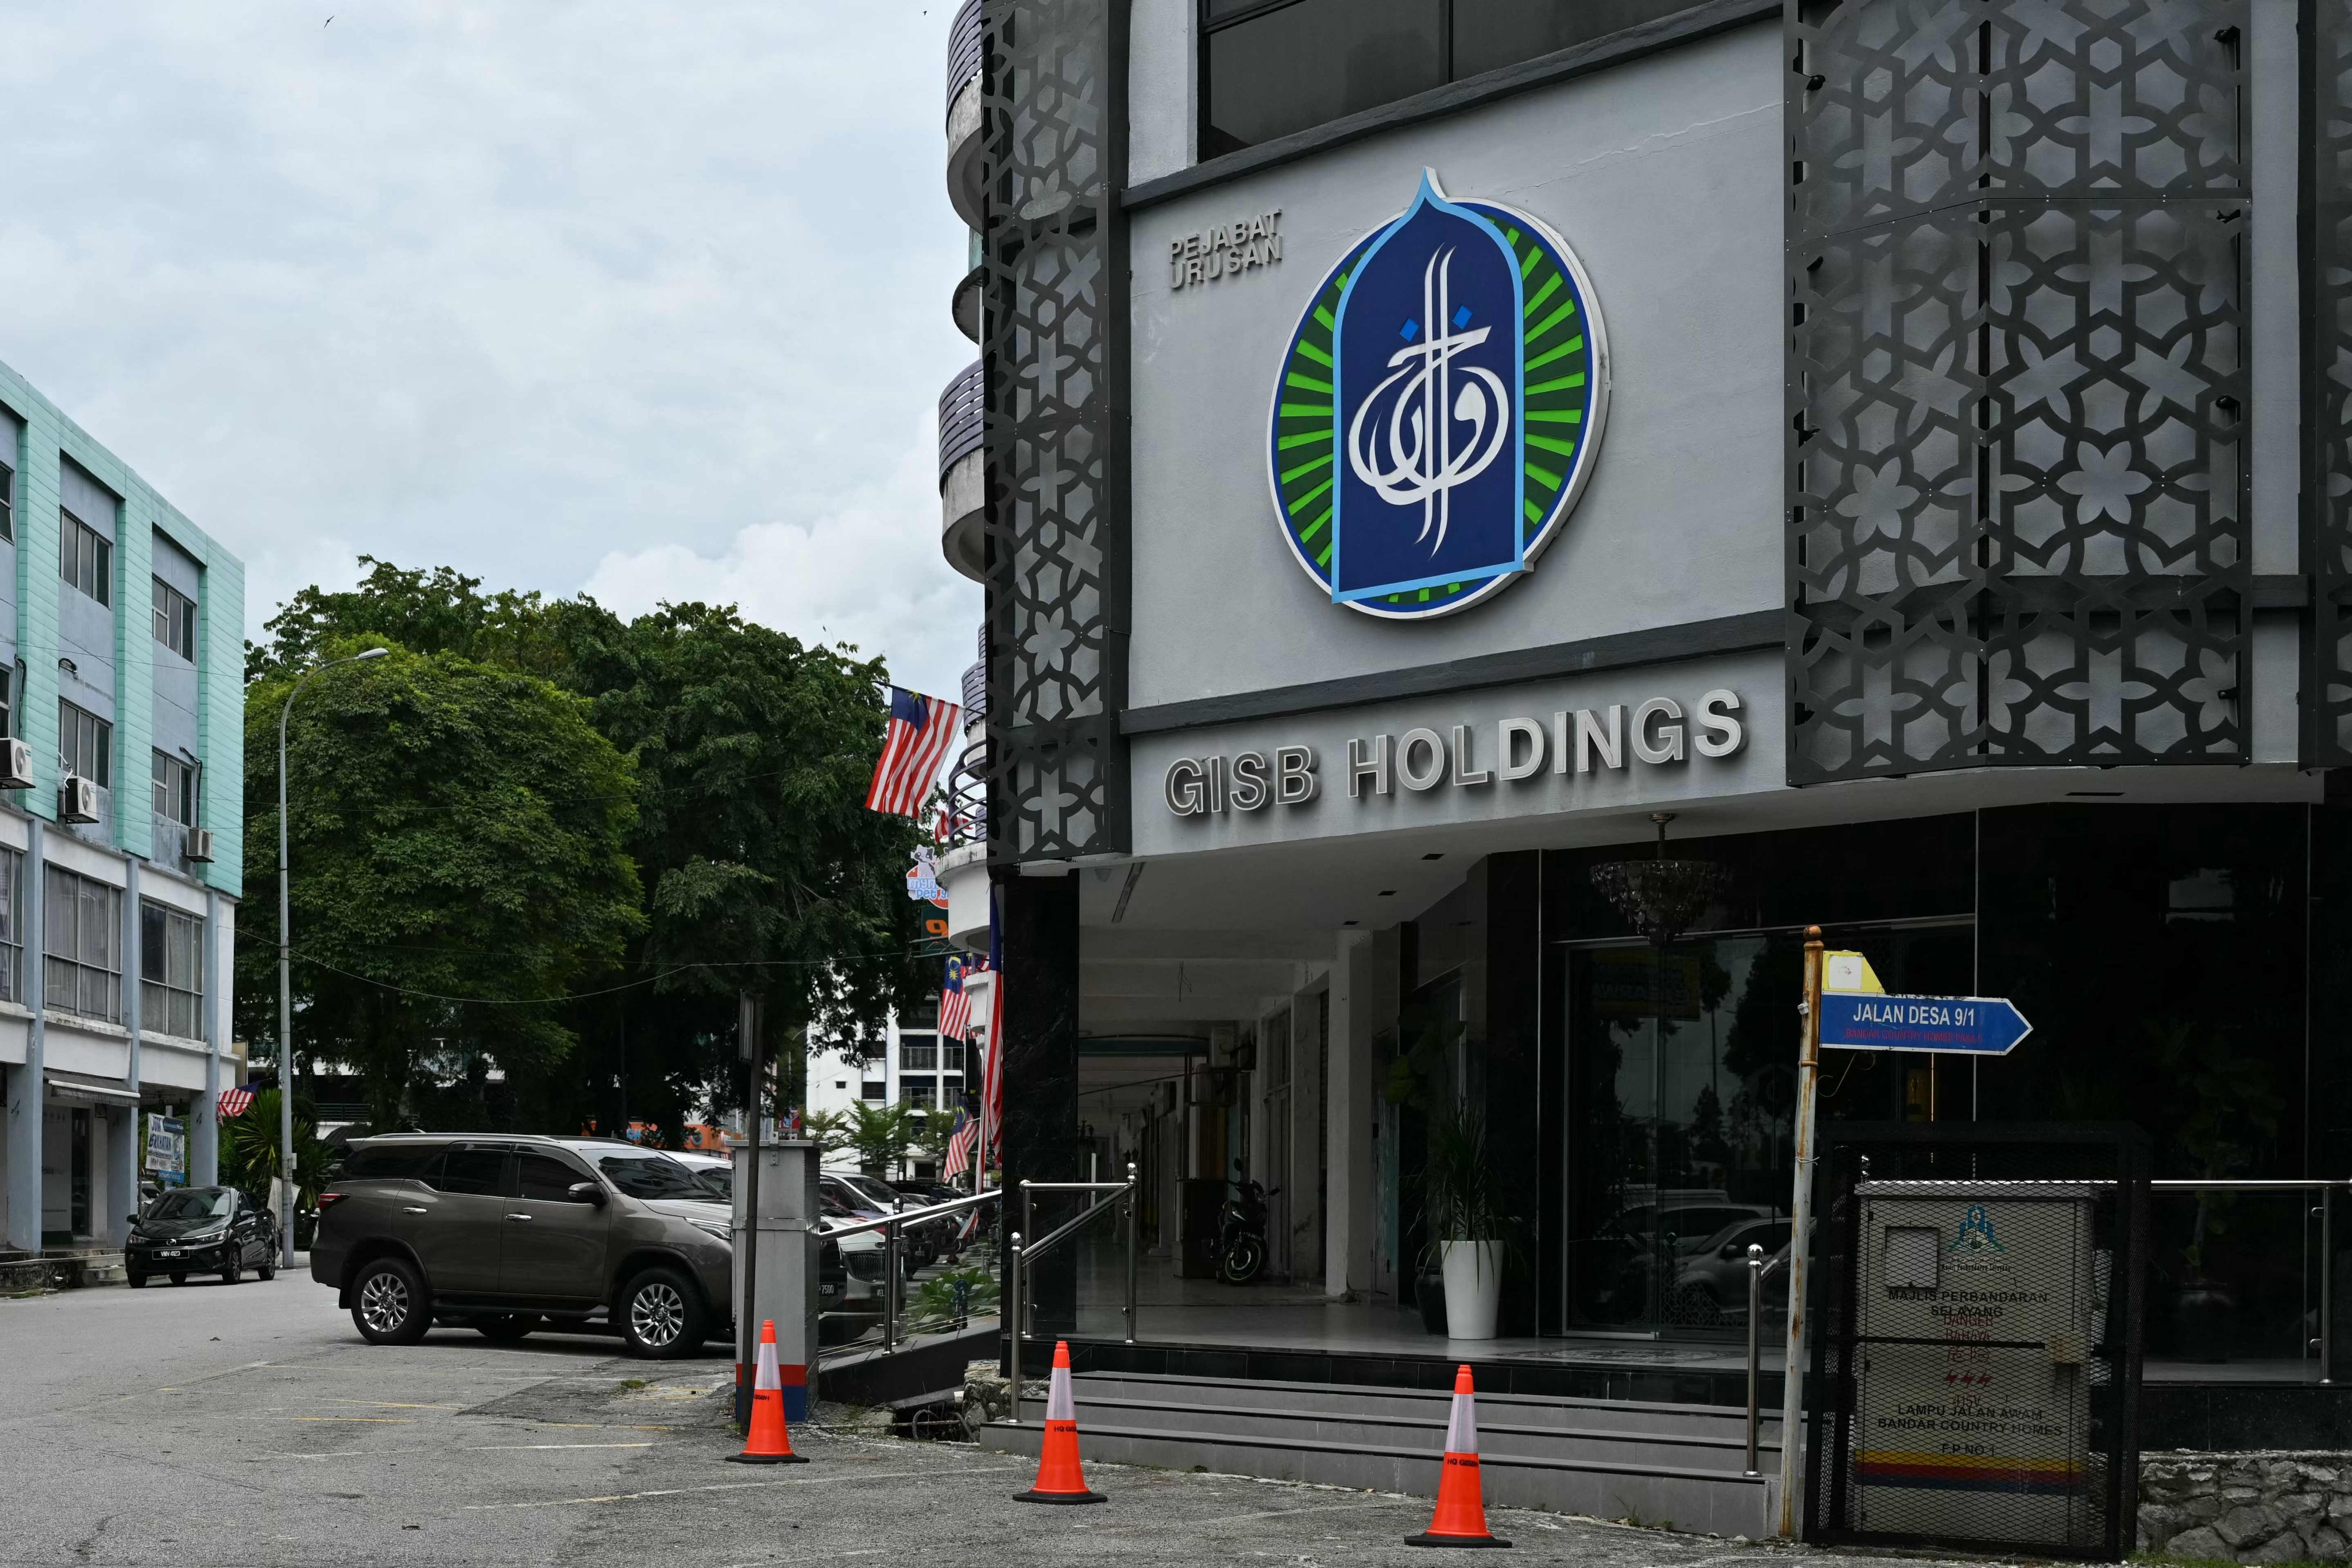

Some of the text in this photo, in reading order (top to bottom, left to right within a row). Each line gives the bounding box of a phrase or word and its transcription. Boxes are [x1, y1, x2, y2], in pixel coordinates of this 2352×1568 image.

[1169, 208, 1282, 264] PEJABAT
[1171, 235, 1283, 288] URUSAN
[1164, 689, 1747, 816] GISB HOLDINGS
[916, 889, 937, 898] pet
[1853, 1003, 1975, 1026] JALAN DESA 9/1
[1845, 1028, 1879, 1039] BANDAR
[1882, 1029, 1921, 1041] COUNTRY
[1924, 1032, 1953, 1042] HOMES
[821, 1284, 834, 1295] 7500
[1888, 1291, 2048, 1303] MAJLIS PERBANDARAN
[1931, 1306, 2003, 1317] SELAYANG
[1944, 1315, 1992, 1326] DANGER
[1897, 1405, 2042, 1420] LAMPU JALAN AWAM
[1878, 1419, 2063, 1436] BANDAR COUNTRY HOMES
